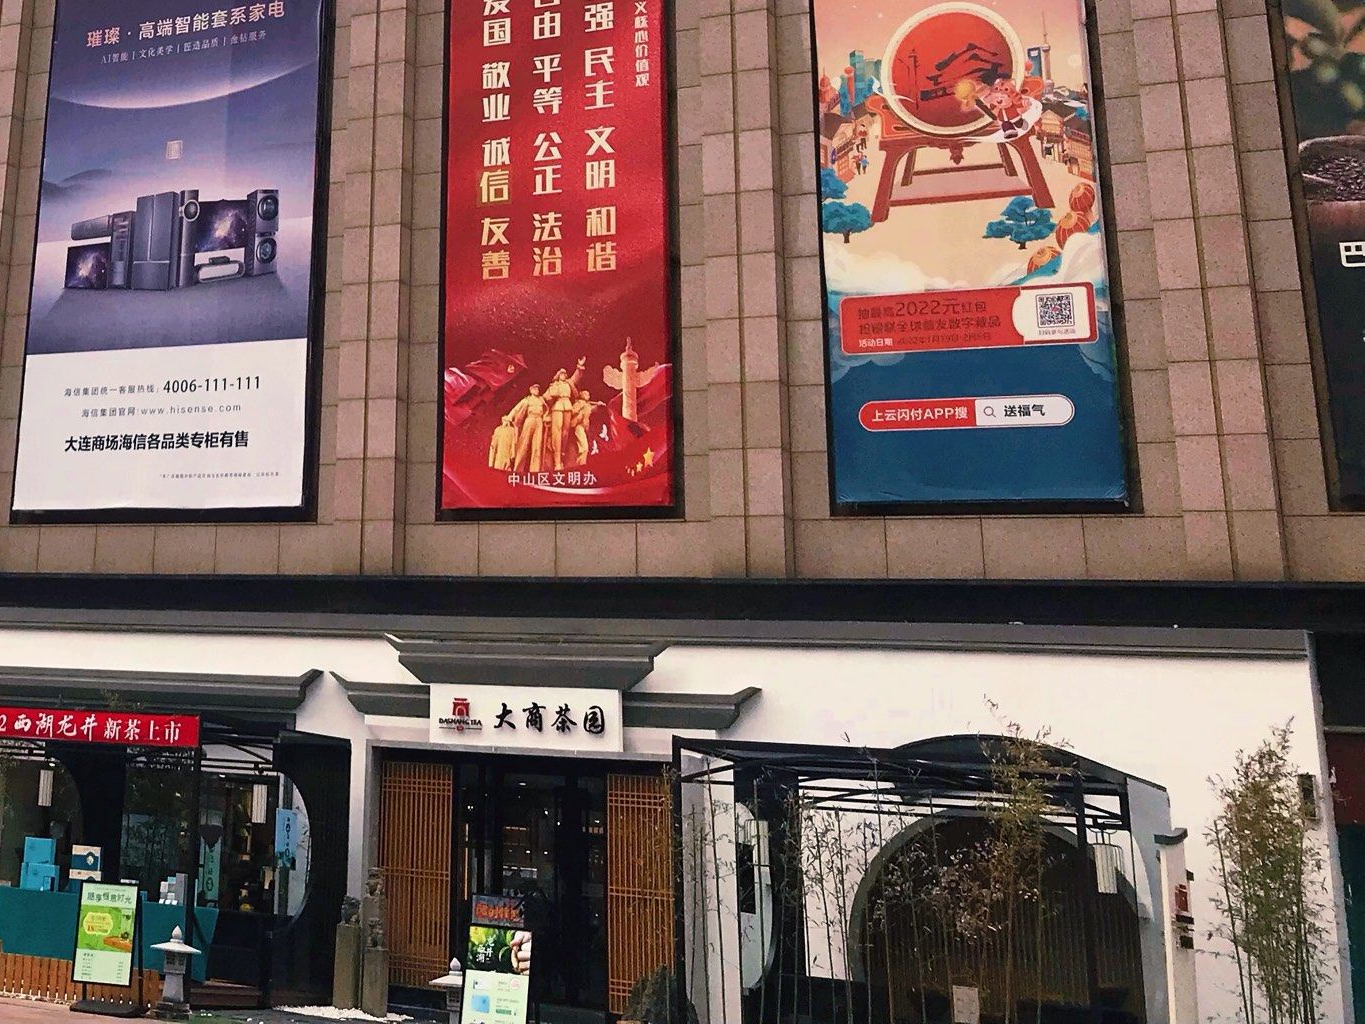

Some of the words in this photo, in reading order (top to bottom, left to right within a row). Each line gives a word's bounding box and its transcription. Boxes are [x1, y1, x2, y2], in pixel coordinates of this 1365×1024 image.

[139, 44, 174, 59] 文化美学
[482, 61, 511, 124] 敬业
[533, 53, 562, 115] 平等
[584, 46, 615, 111] 民主
[480, 136, 511, 203] 诚信
[533, 131, 563, 196] 公正
[584, 124, 616, 190] 文明
[481, 217, 511, 280] 友善
[533, 212, 563, 277] 法治
[586, 206, 617, 273] 和谐
[858, 337, 893, 348] 活动日期
[163, 375, 261, 394] 4006-111-111
[871, 406, 968, 423] 上云闪付APP搜
[1004, 404, 1046, 418] 送福气
[64, 430, 249, 453] 大连商场海信各品类专柜有售
[508, 472, 597, 487] 中山区文明办
[14, 712, 182, 744] 西湖龙井新茶上市
[439, 717, 470, 726] DASHANG
[471, 718, 483, 726] TEA
[493, 702, 605, 735] 大商茶园
